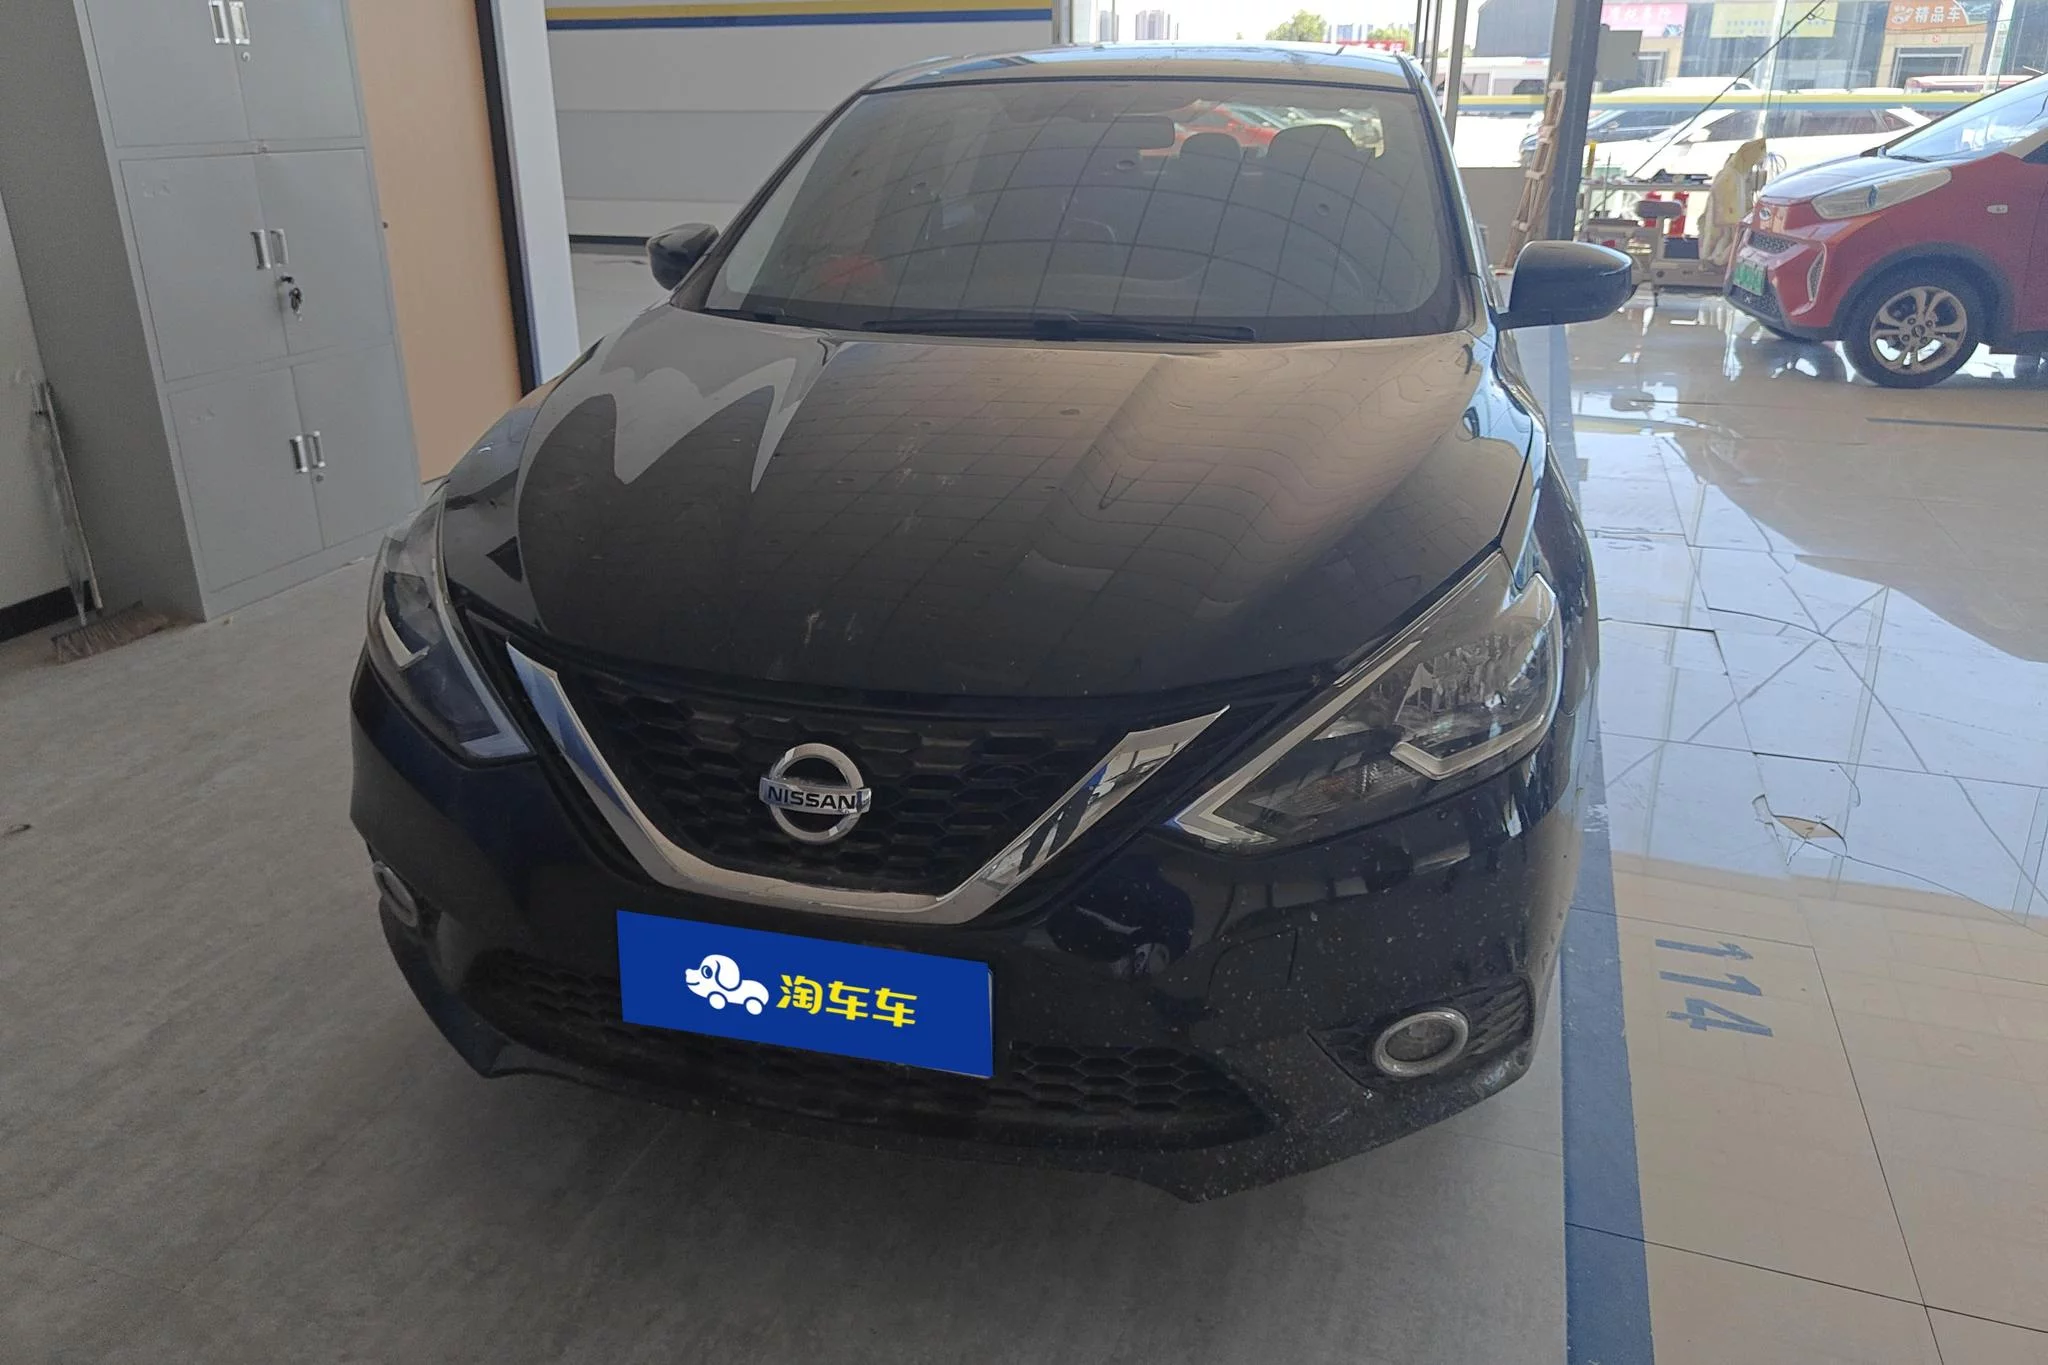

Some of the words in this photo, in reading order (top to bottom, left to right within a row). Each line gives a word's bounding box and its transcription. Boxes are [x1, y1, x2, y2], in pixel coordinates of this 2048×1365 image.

[1915, 5, 1961, 24] 精品车
[768, 786, 856, 809] NISSAN
